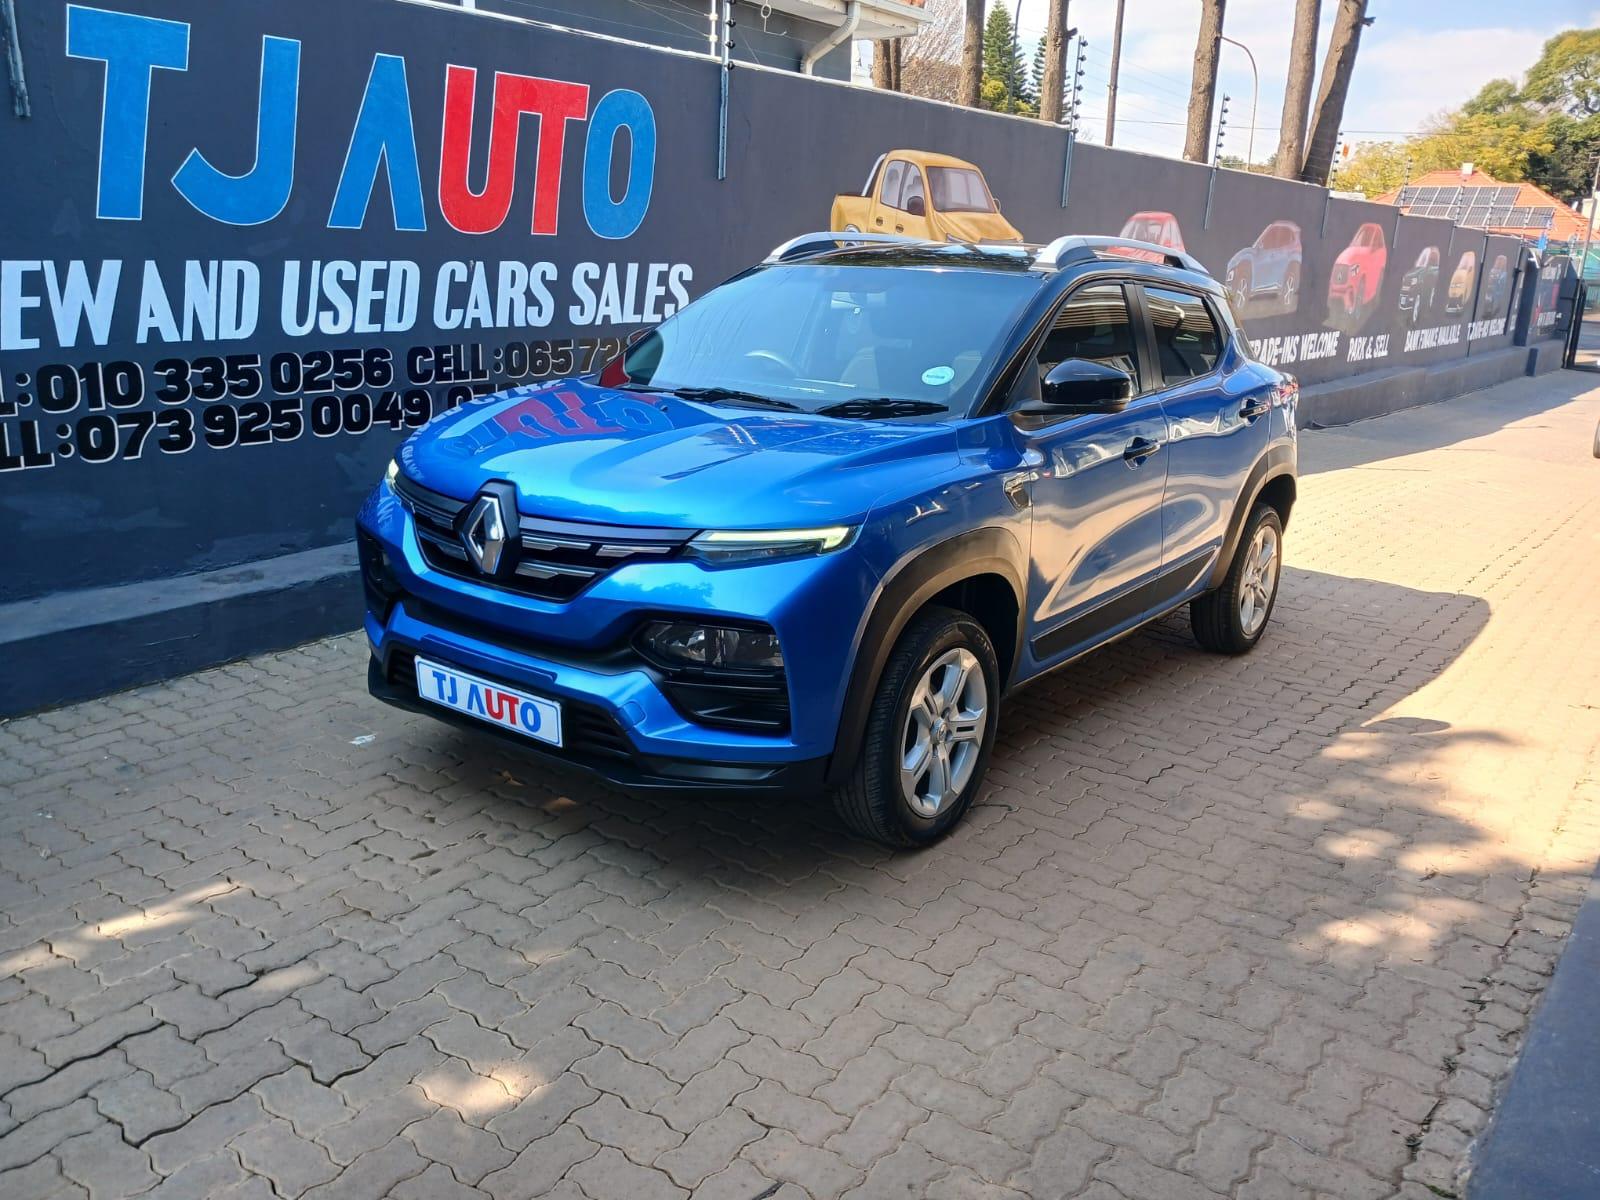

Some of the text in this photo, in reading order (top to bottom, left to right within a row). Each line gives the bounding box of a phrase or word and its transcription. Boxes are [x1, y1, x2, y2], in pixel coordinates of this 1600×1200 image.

[66, 4, 656, 239] TJ AUTO
[0, 260, 693, 349] EW AND USED CARS SALES
[1299, 331, 1340, 360] WELCOME
[1347, 336, 1366, 362] PARK
[1373, 333, 1390, 359] SELL
[153, 353, 263, 405] 335
[270, 347, 393, 395] 0256
[203, 398, 304, 449] 925
[311, 389, 433, 434] 0049
[432, 671, 541, 733] TJ AUTO
